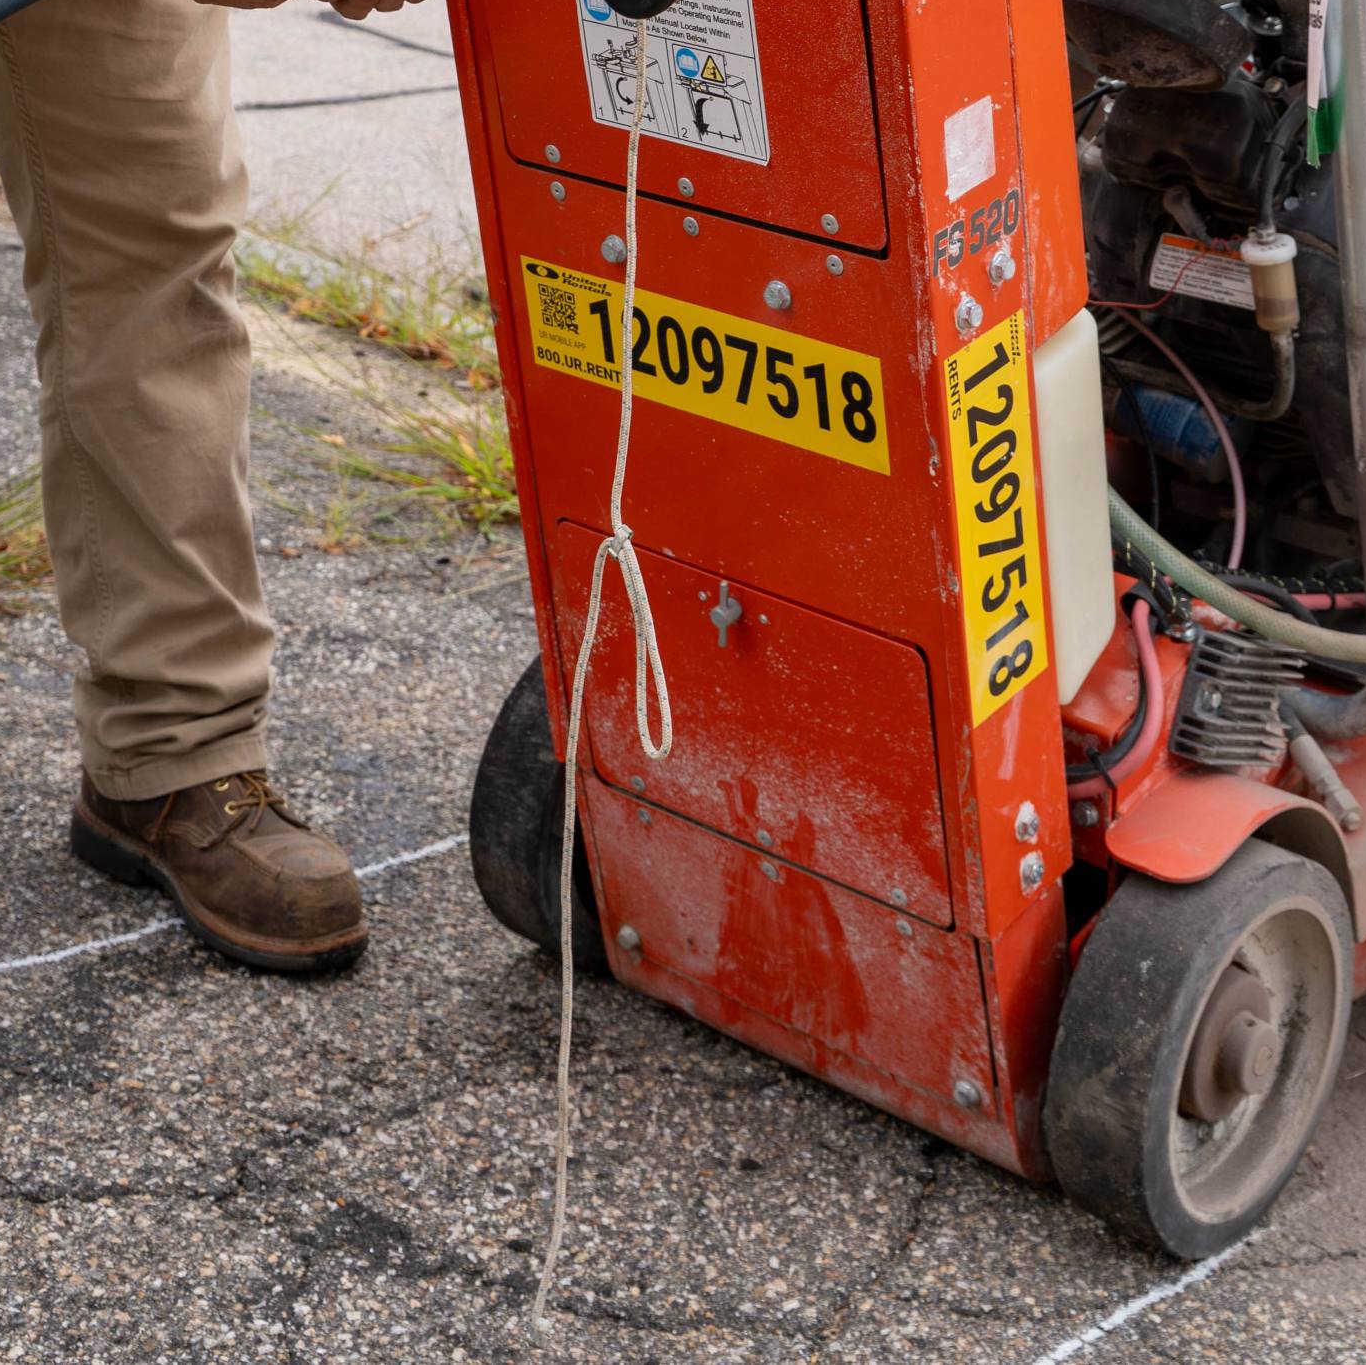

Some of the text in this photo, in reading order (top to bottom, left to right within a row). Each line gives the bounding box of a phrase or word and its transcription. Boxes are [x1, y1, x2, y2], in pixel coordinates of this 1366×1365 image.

[678, 6, 712, 23] Operating
[713, 15, 745, 29] Machine!
[702, 2, 742, 18] Instructions
[651, 24, 661, 34] As
[661, 26, 685, 39] Shown
[686, 32, 709, 45] Below.
[654, 16, 680, 28] Manual
[680, 21, 708, 35] Located
[708, 28, 731, 39] Within
[599, 107, 604, 117] 1
[681, 128, 689, 139] 2
[932, 186, 1020, 277] FS 520
[561, 271, 608, 290] United
[562, 278, 613, 298] Rentals
[549, 331, 573, 347] MOBILE
[536, 345, 623, 384] 800.UR.RENT
[588, 298, 879, 444] 12097518
[963, 340, 1035, 698] 12097518
